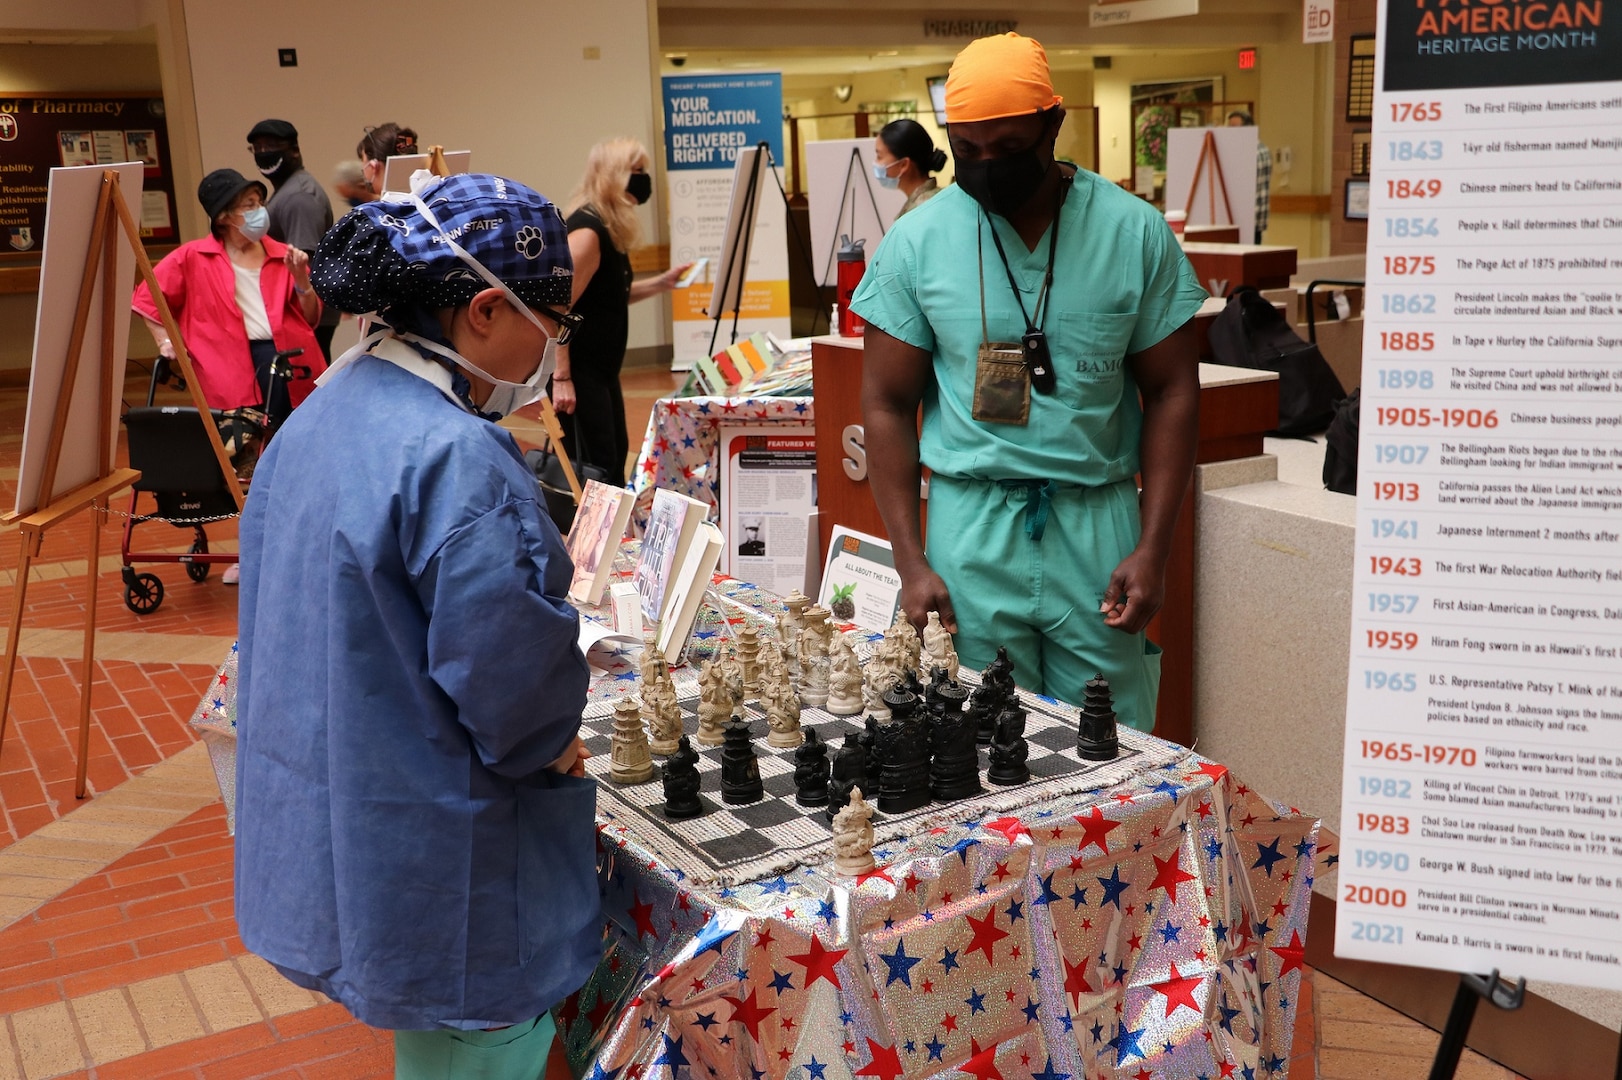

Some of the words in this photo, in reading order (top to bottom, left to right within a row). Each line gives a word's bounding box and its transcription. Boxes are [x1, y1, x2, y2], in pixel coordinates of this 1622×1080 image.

[1093, 10, 1131, 22] Pharmacy
[1416, 0, 1603, 36] AMERICAN
[924, 20, 1018, 37] PHARMACY
[1418, 36, 1510, 55] HERITAGE
[1516, 30, 1598, 50] MONTH
[1239, 51, 1256, 68] EXIT
[2, 100, 20, 114] of
[32, 100, 125, 117] Pharmacy
[671, 96, 709, 112] YOUR
[1391, 102, 1442, 122] 1765
[1464, 102, 1481, 114] The
[1483, 102, 1505, 114] First
[1507, 100, 1542, 114] Filipino
[1545, 100, 1597, 111] Americans
[672, 110, 760, 127] MEDICATION.
[673, 132, 746, 148] DELIVERED
[673, 147, 714, 163] RIGHT
[1389, 141, 1443, 161] 1843
[1463, 142, 1483, 154] 14yr
[1486, 142, 1500, 153] old
[1503, 141, 1552, 152] fisherman
[1554, 140, 1588, 150] named
[1387, 179, 1442, 199] 1849
[1460, 182, 1496, 193] Chinese
[1499, 183, 1532, 192] miners
[1534, 182, 1558, 192] head
[1561, 181, 1571, 191] to
[1385, 218, 1439, 238] 1854
[1458, 220, 1488, 232] People
[1502, 219, 1520, 230] Hall
[1523, 220, 1577, 230] determines
[1580, 218, 1600, 229] that
[1384, 256, 1435, 275] 1875
[1456, 258, 1472, 269] The
[1475, 258, 1498, 272] Page
[1500, 258, 1515, 269] Act
[1518, 258, 1528, 269] of
[1532, 257, 1555, 269] 1875
[1557, 258, 1607, 270] prohibited
[1381, 294, 1436, 314] 1862
[1380, 332, 1435, 351] 1885
[1452, 335, 1461, 346] In
[1464, 335, 1485, 348] Tape
[1488, 338, 1493, 346] v
[1496, 336, 1526, 348] Hurley
[1529, 336, 1544, 346] the
[1547, 336, 1593, 347] California
[1378, 369, 1434, 389] 1898
[1377, 408, 1499, 428] 1905-1906
[1510, 413, 1547, 424] Chinese
[1550, 415, 1592, 425] business
[842, 424, 868, 481] S
[1375, 444, 1429, 464] 1907
[1373, 482, 1419, 501] 1913
[1371, 519, 1418, 539] 1941
[1437, 526, 1482, 538] Japanese
[1486, 527, 1540, 539] Internment
[1544, 527, 1549, 540] 2
[1553, 530, 1590, 541] months
[1594, 531, 1619, 542] after
[845, 563, 854, 572] ALL
[855, 566, 872, 576] ABOUT
[873, 572, 884, 582] THE
[1370, 556, 1422, 576] 1943
[1435, 560, 1452, 573] The
[1455, 562, 1475, 574] first
[1478, 563, 1497, 575] War
[1500, 565, 1552, 578] Relocation
[1556, 567, 1602, 582] Authority
[1368, 593, 1419, 614] 1957
[1433, 598, 1454, 610] First
[1457, 601, 1534, 615] Asian-American
[1537, 606, 1547, 616] in
[1366, 630, 1418, 650] 1959
[1431, 636, 1459, 648] Hiram
[1462, 639, 1485, 653] Fong
[1488, 641, 1518, 652] sworn
[1521, 643, 1531, 653] in
[1534, 644, 1546, 654] as
[1594, 646, 1616, 658] first
[1364, 670, 1416, 692] 1965
[1429, 673, 1446, 686] U.S.
[1451, 677, 1523, 692] Representative
[1526, 680, 1553, 695] Patsy
[1568, 683, 1592, 696] Mink
[1596, 685, 1607, 697] of
[1427, 712, 1460, 724] policies
[1463, 714, 1489, 725] based
[1492, 717, 1503, 726] on
[1505, 717, 1544, 730] ethnicity
[1547, 720, 1564, 730] and
[1566, 722, 1588, 732] race.
[1361, 740, 1476, 767] 1965-1970
[1359, 776, 1411, 798] 1982
[1357, 813, 1410, 835] 1983
[1355, 849, 1409, 872] 1990
[1419, 859, 1453, 873] George
[1470, 862, 1494, 876] Bush
[1497, 867, 1530, 882] signed
[1533, 870, 1552, 882] into
[1556, 873, 1573, 884] law
[1577, 874, 1591, 886] for
[1595, 876, 1612, 888] the
[1344, 884, 1407, 908] 2000
[1351, 922, 1403, 944] 2021
[1415, 932, 1448, 944] Kamala
[1463, 937, 1491, 949] Harris
[1494, 941, 1502, 951] is
[1505, 943, 1533, 954] sworn
[1536, 946, 1545, 956] in
[1548, 948, 1559, 958] as
[1562, 948, 1582, 960] first
